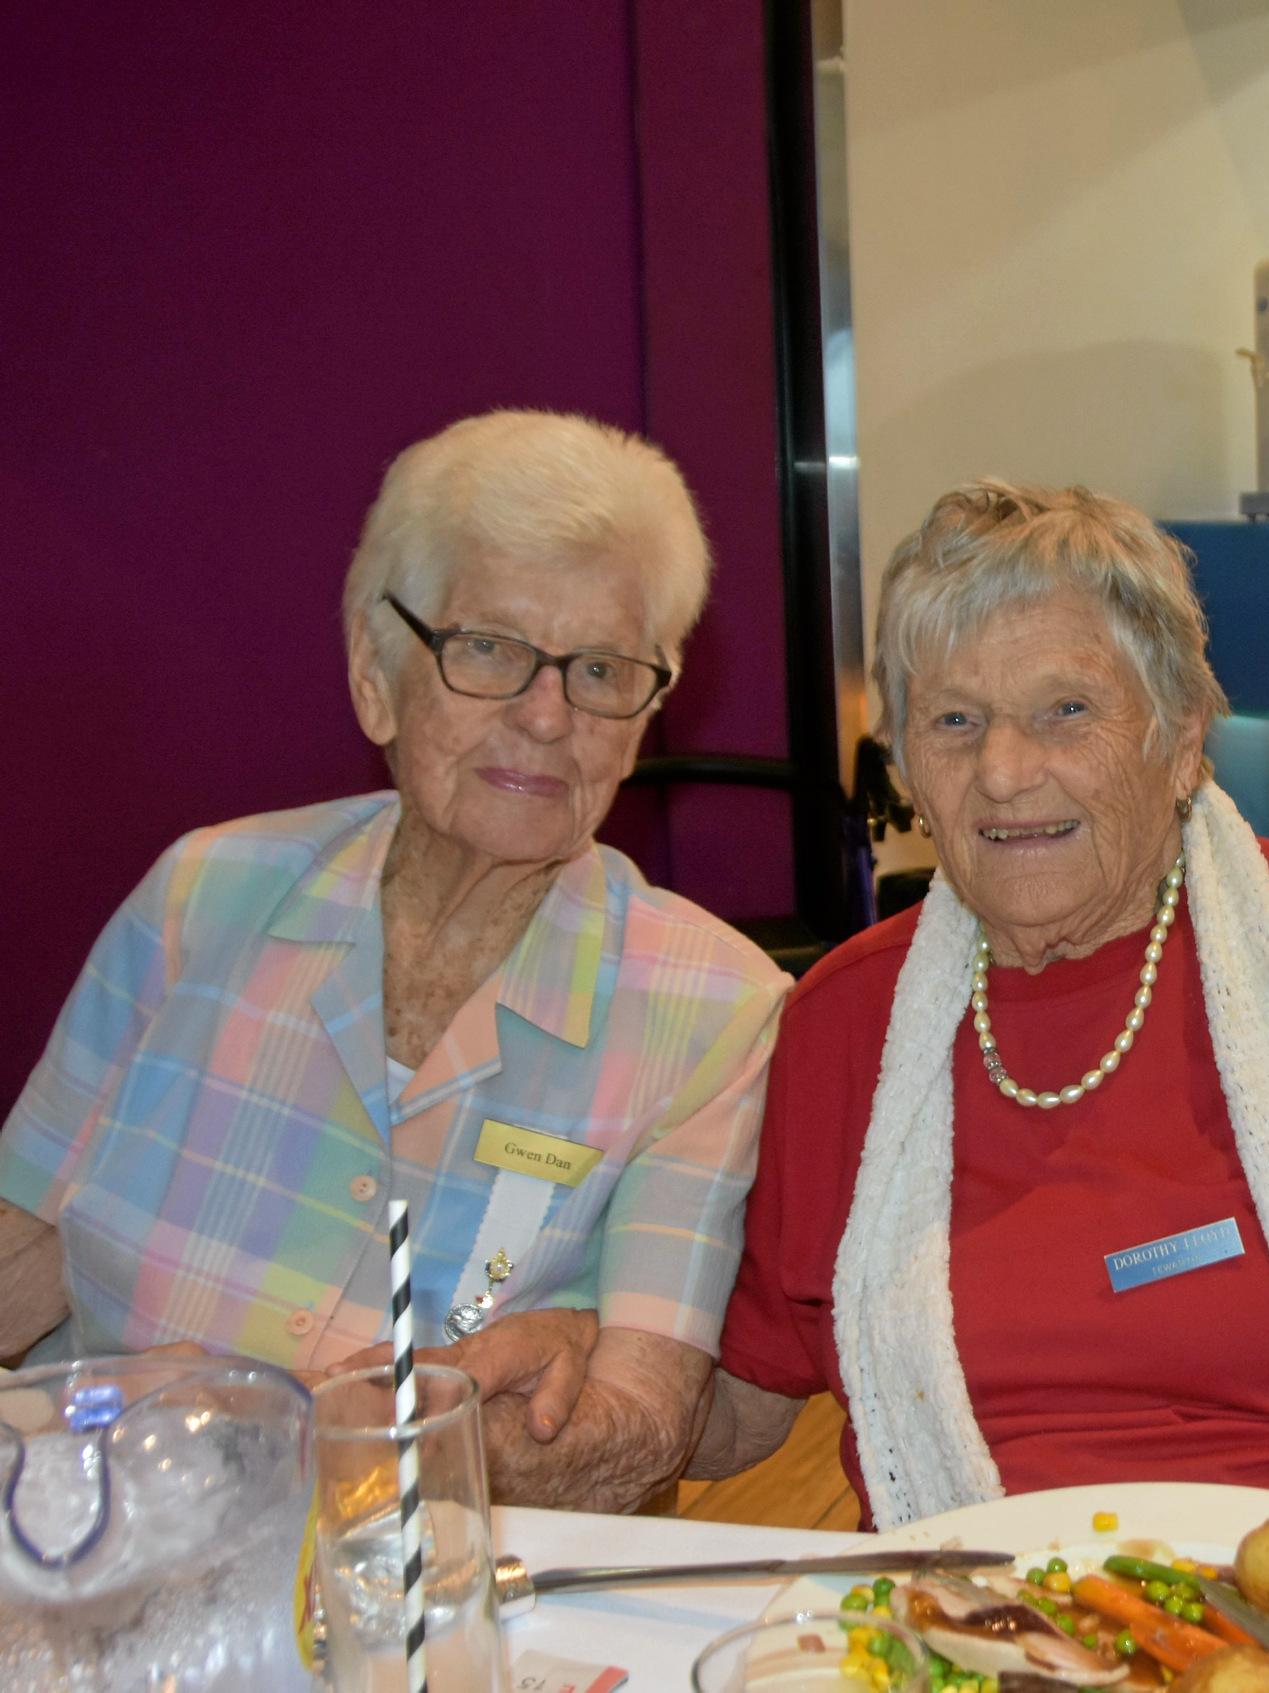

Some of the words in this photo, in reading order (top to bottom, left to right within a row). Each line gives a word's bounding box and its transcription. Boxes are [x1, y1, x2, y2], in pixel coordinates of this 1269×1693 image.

[504, 1142, 541, 1162] Gwen
[546, 1153, 571, 1170] Dan
[1113, 1240, 1177, 1271] DOROTHY
